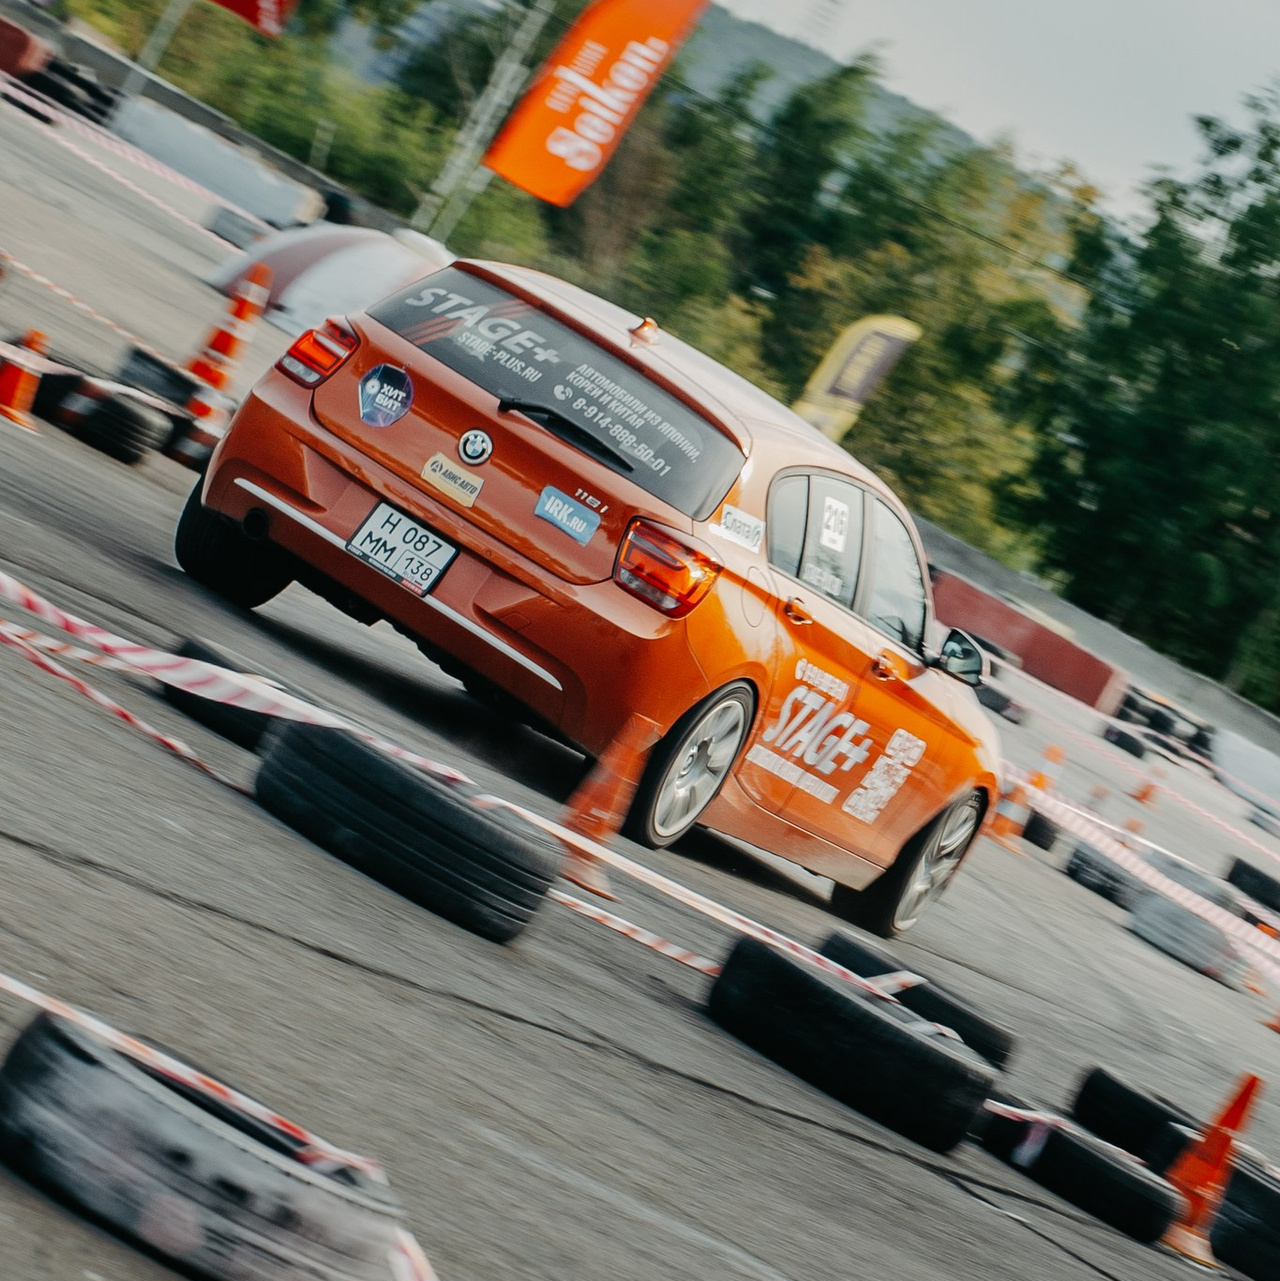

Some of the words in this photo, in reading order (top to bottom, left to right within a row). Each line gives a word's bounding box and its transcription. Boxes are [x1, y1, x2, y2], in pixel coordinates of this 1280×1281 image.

[405, 287, 560, 363] STAGE+
[457, 331, 542, 383] STAGE-PLUS.RU
[375, 392, 402, 412] БИТ
[380, 382, 407, 402] ХИТ
[575, 363, 648, 415] АВТОМОБИЛИ
[643, 409, 662, 426] ИЗ
[656, 421, 701, 464] ЯПОНИИ,
[598, 394, 611, 407] И
[607, 399, 646, 430] КИТАЯ
[440, 468, 462, 486] АВИС
[458, 476, 478, 495] АВТО
[380, 512, 402, 535] Н
[402, 527, 443, 558] 087
[543, 494, 588, 533] IRK.RU
[360, 530, 397, 562] ММ
[404, 556, 433, 581] 138
[762, 685, 874, 775] STAGE+
